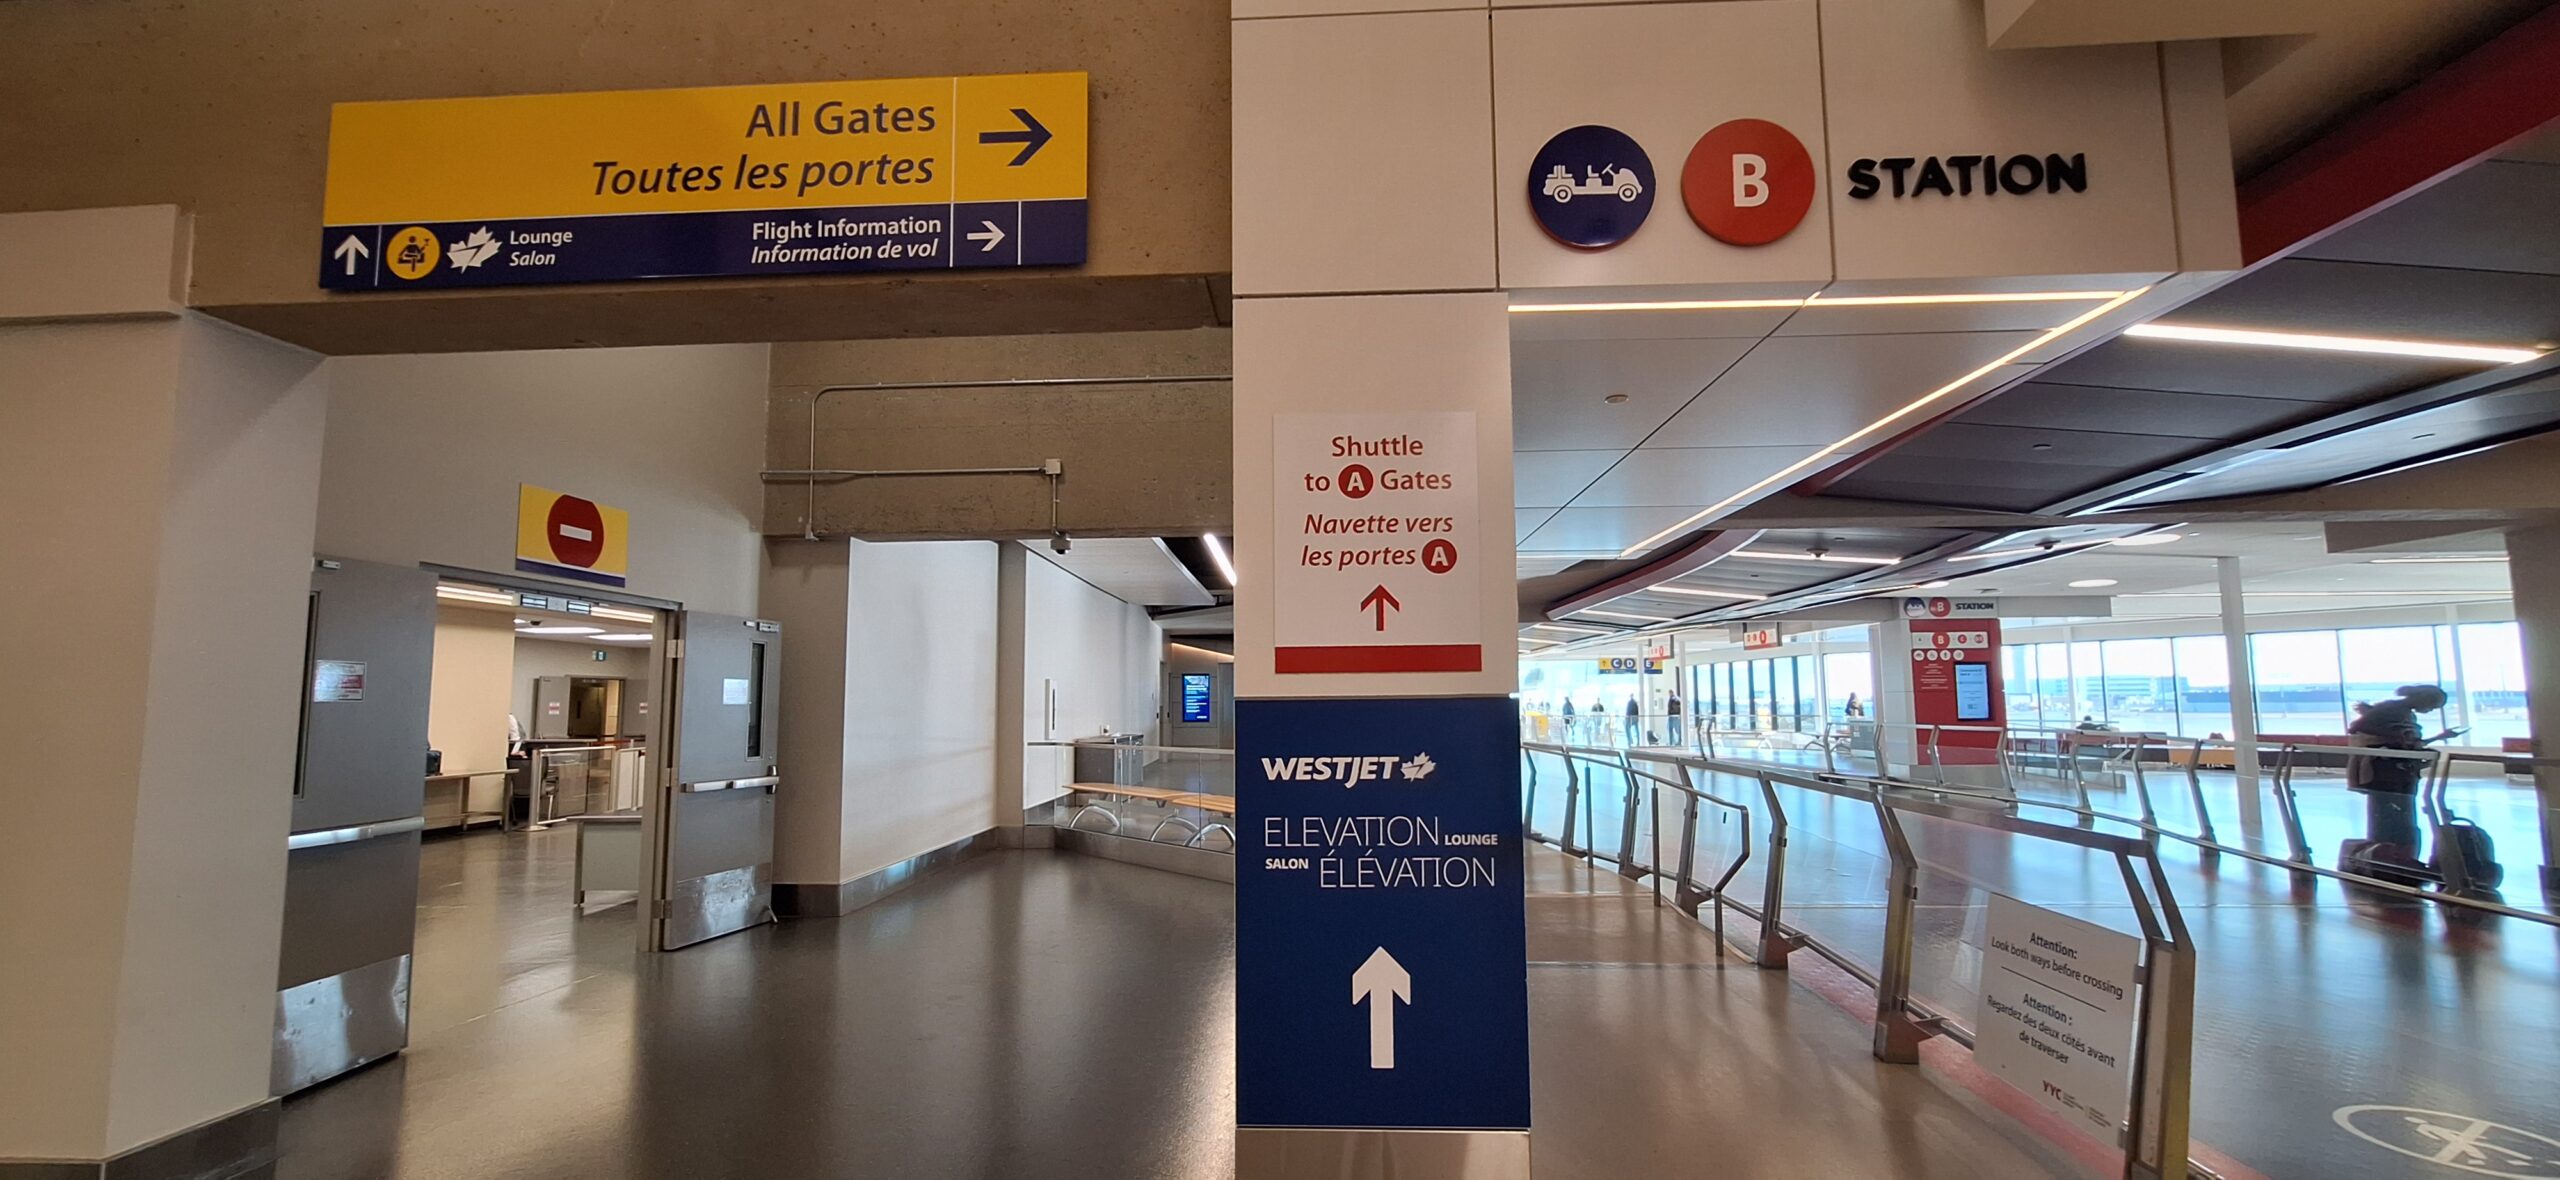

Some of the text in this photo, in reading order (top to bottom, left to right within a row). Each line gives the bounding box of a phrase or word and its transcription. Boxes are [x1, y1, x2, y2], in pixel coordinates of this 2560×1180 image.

[745, 100, 936, 138] All Gates
[592, 153, 934, 197] Toutes les portes
[1732, 152, 2087, 208] B STATION
[510, 230, 573, 246] Lounge
[751, 217, 941, 244] Flight Information
[509, 251, 555, 266] Salon
[751, 238, 938, 265] Information de vol
[1331, 435, 1423, 457] Shuttle
[1304, 469, 1452, 492] to A Gates
[1304, 513, 1453, 534] Navette vers
[1301, 545, 1449, 571] les portes A
[1937, 602, 1994, 612] B STATION
[1261, 756, 1399, 789] WESTJET
[1264, 815, 1499, 847] ELEVATION LOUNGE
[1265, 849, 1495, 888] SALON ÉLÉVATION
[2029, 932, 2078, 960] Attention:
[1991, 936, 2123, 1000] Look both ways before crossing
[1986, 995, 2022, 1021] Regardez
[2023, 1013, 2037, 1029] des
[2038, 1020, 2060, 1040] deux
[2087, 1046, 2115, 1068] avant
[2019, 1030, 2070, 1064] de traverser
[2043, 1080, 2062, 1100] YYC
